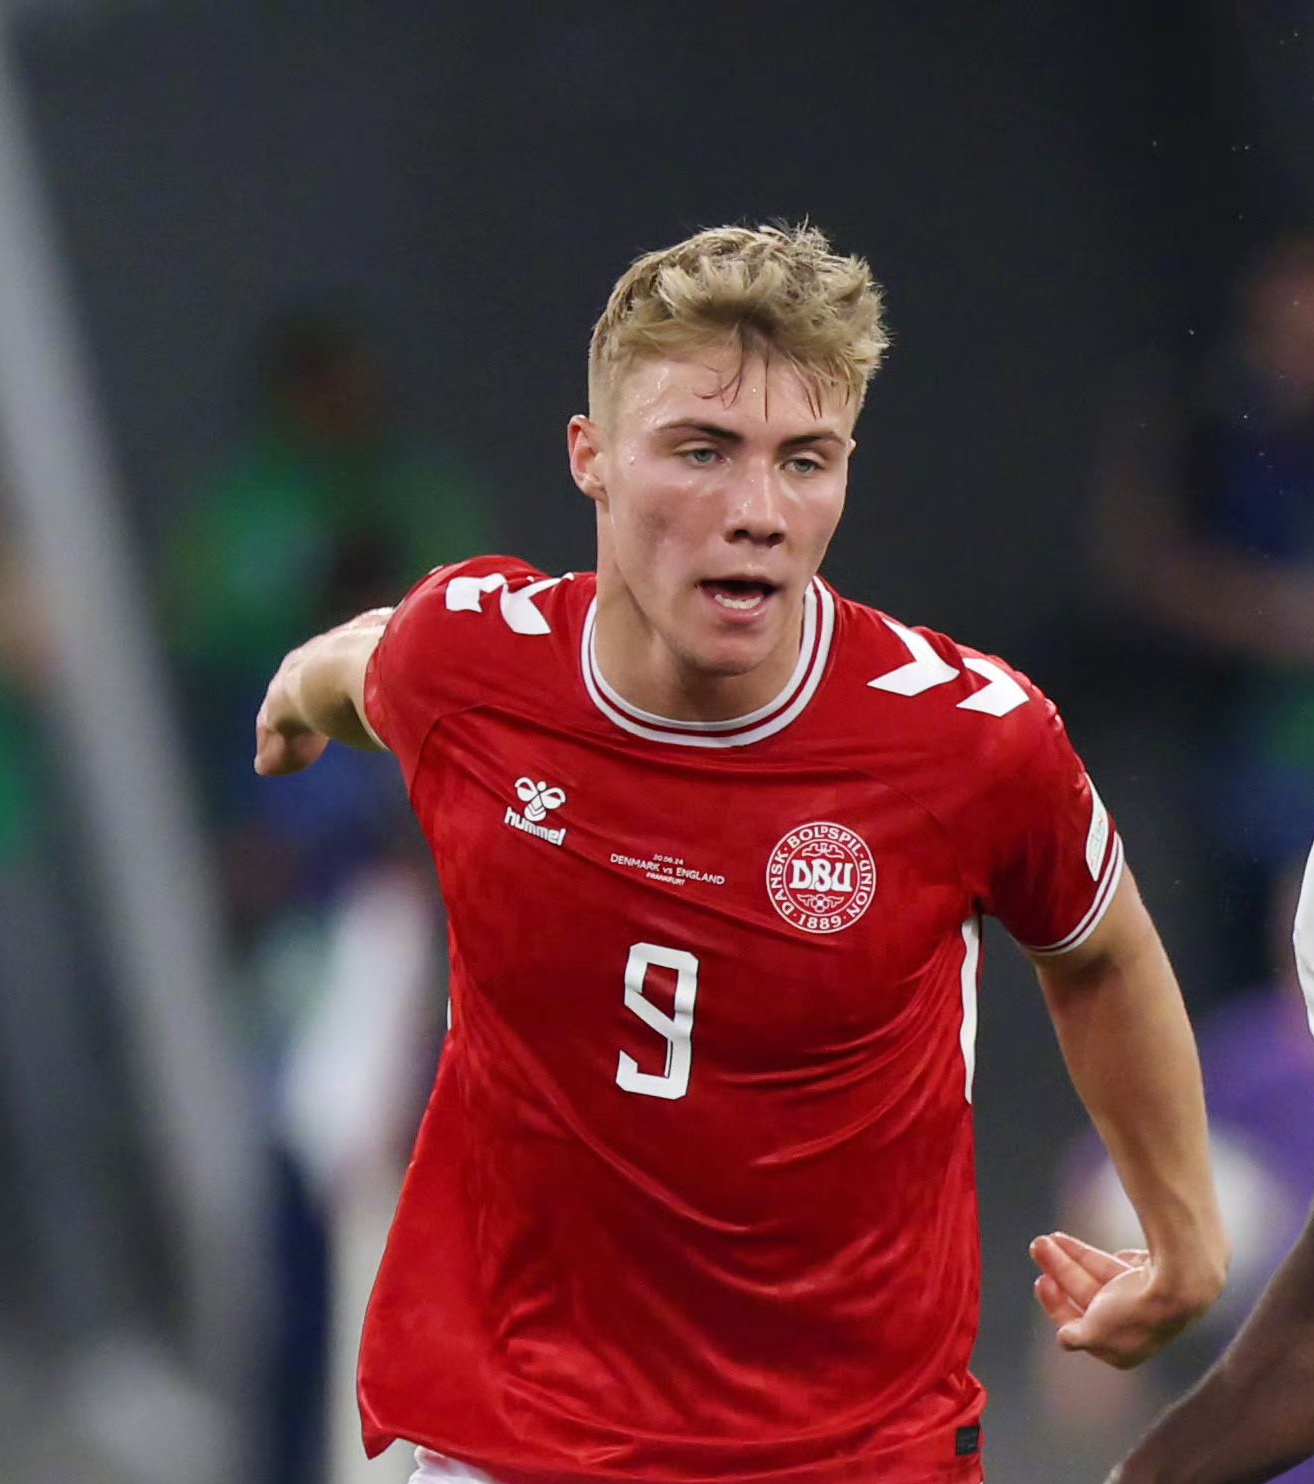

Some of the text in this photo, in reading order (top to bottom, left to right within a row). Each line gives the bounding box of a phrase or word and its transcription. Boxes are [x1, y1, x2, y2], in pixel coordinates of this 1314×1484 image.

[504, 807, 566, 846] hummel
[610, 853, 725, 885] DENMARK vs ENGLAND
[770, 850, 795, 915] DANSK
[789, 858, 854, 892] DBU
[846, 859, 872, 918] UNION
[798, 914, 842, 930] 1889
[615, 942, 698, 1100] 9
